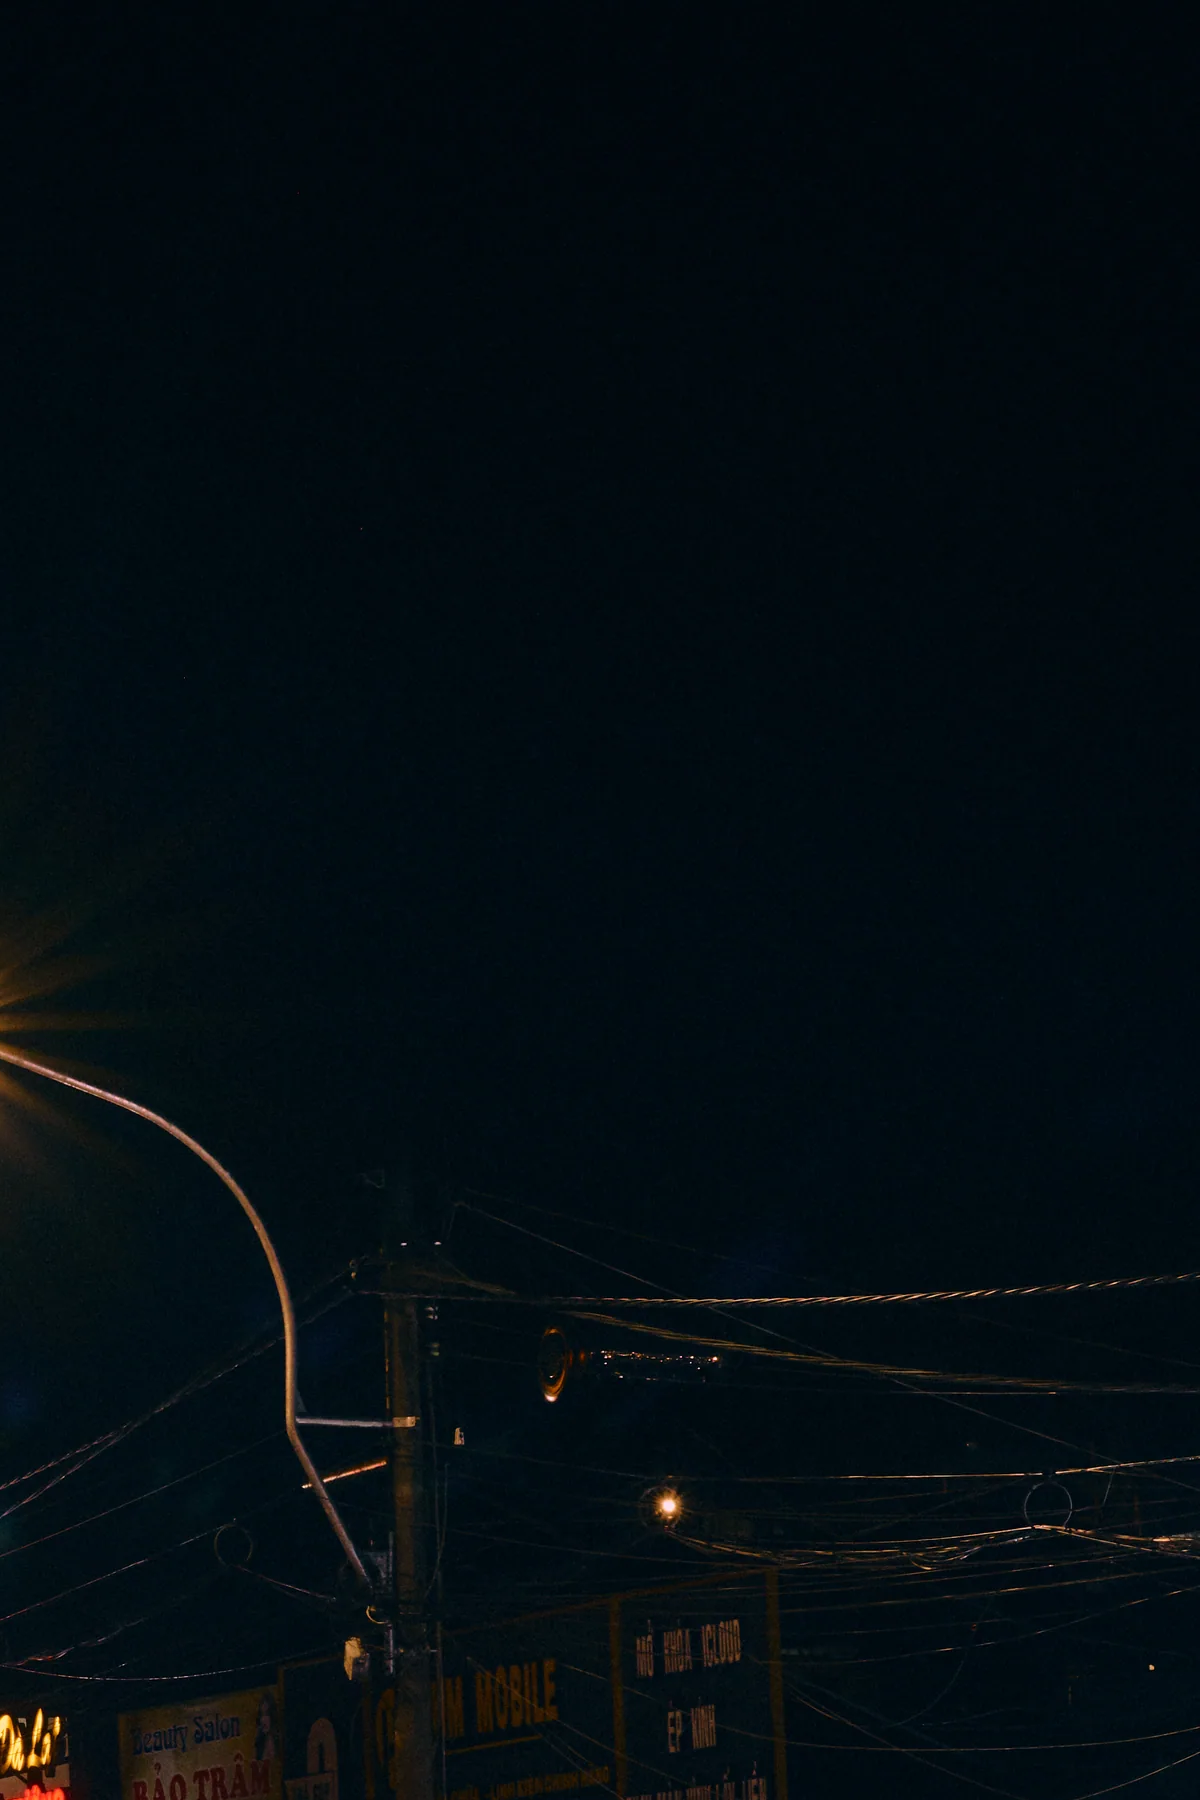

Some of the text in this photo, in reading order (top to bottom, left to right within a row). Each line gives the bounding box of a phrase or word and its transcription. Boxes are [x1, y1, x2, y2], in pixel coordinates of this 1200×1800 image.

[476, 1658, 559, 1733] MOBILE
[132, 1712, 240, 1755] Beauty Salon
